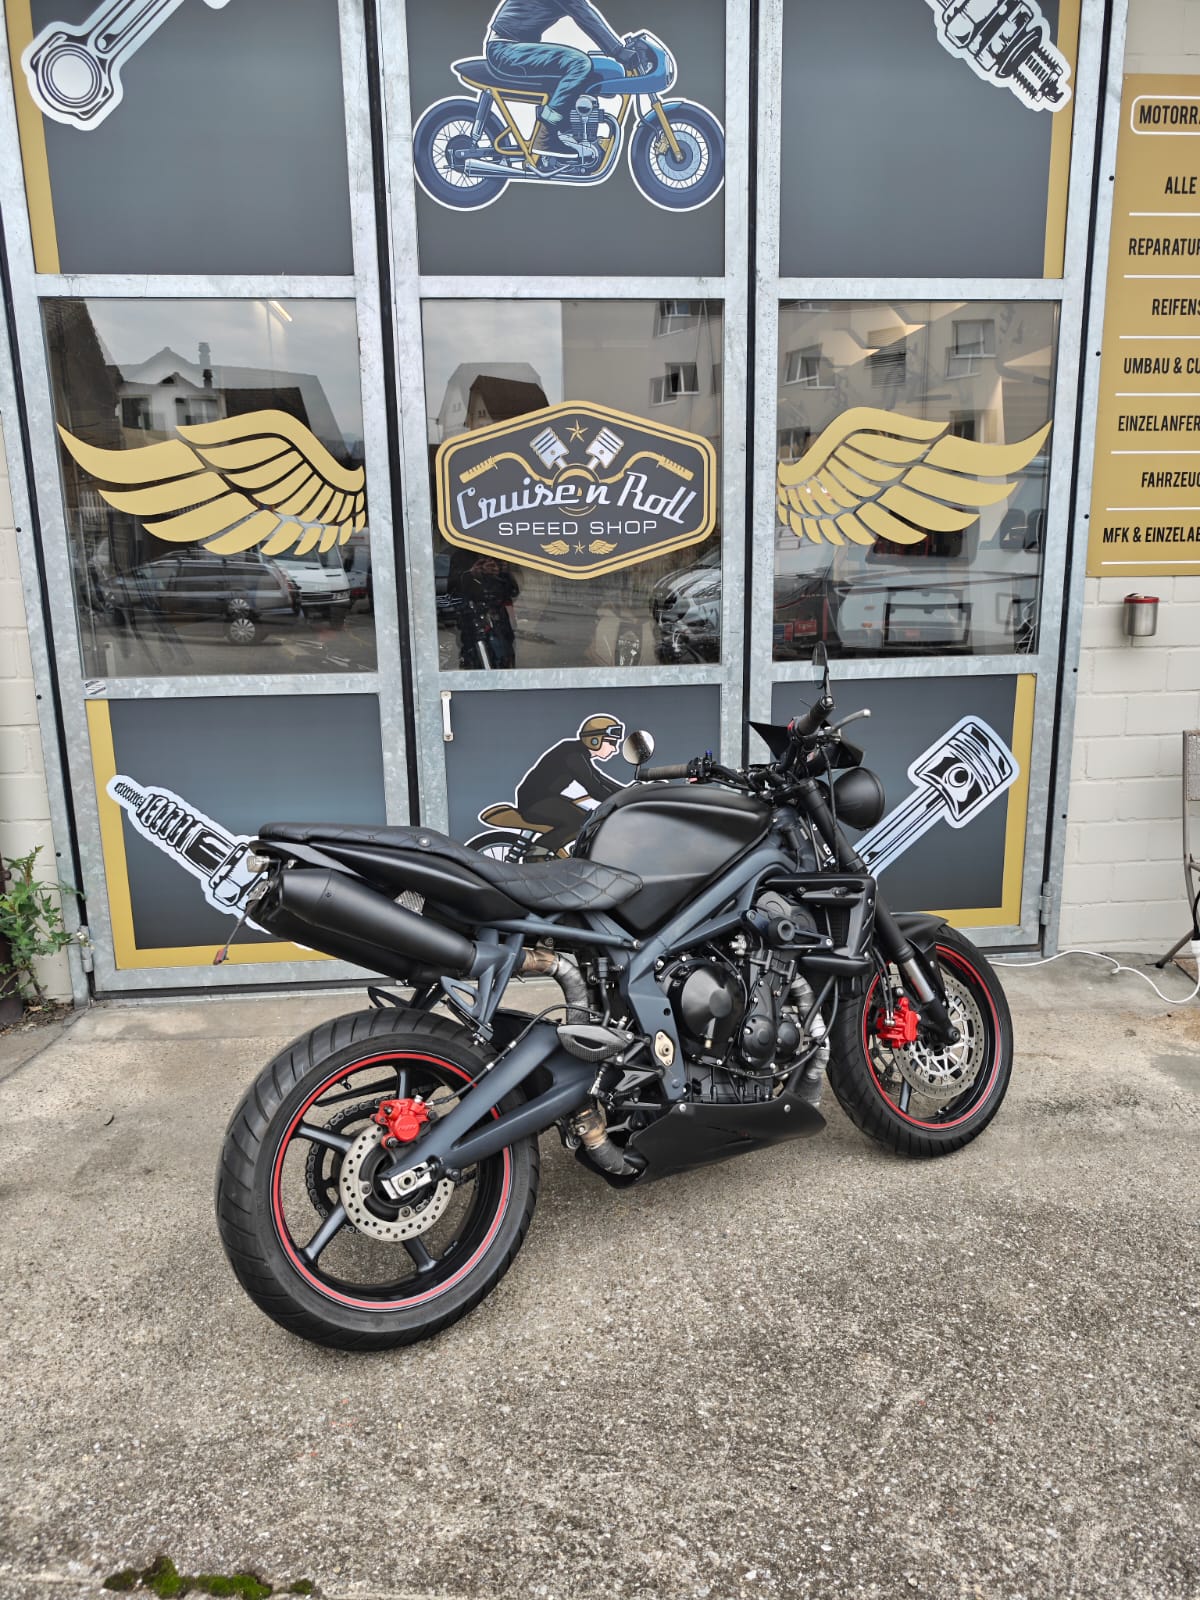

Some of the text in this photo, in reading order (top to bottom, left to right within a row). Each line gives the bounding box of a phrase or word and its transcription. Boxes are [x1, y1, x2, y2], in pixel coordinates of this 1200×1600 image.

[1139, 104, 1200, 125] MOTORR
[1164, 176, 1197, 194] ALLE
[1123, 357, 1170, 375] UMBAU
[1173, 356, 1182, 374] &
[617, 471, 697, 524] Roll
[498, 520, 657, 536] SPEED SHOP
[1102, 526, 1130, 543] MFK
[1132, 527, 1142, 543] &
